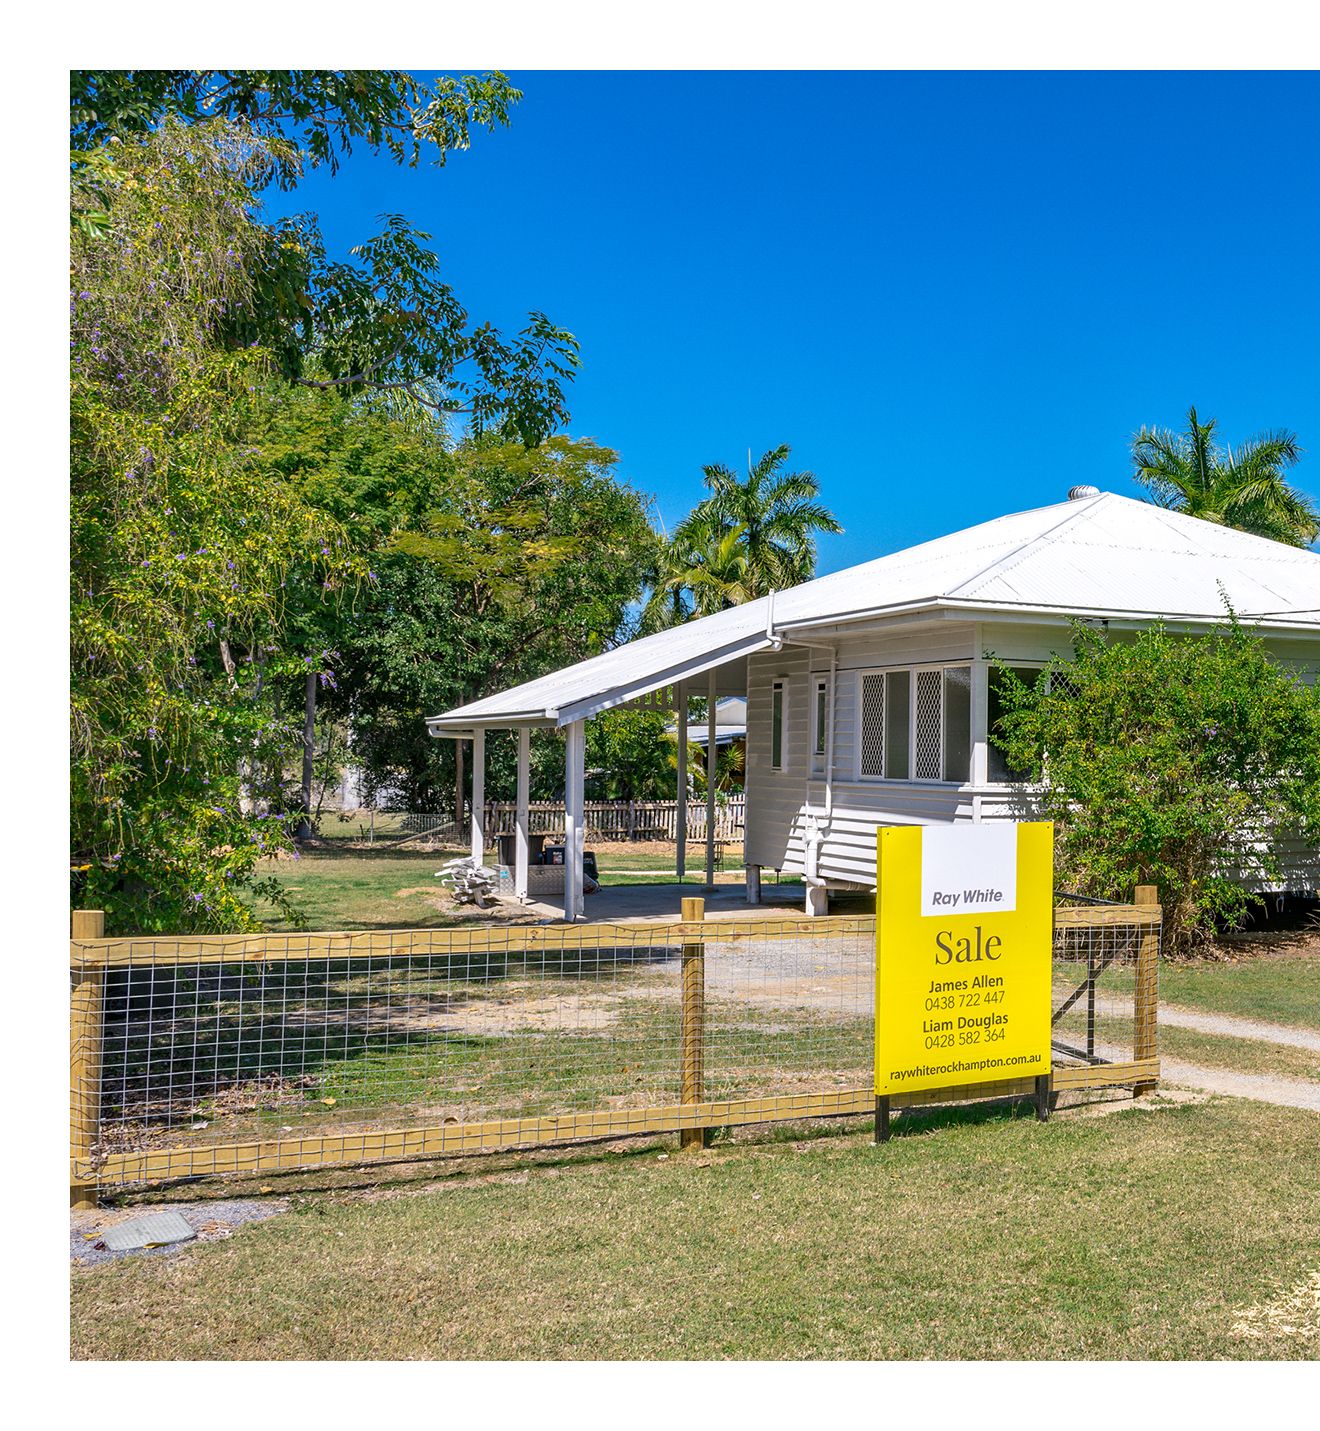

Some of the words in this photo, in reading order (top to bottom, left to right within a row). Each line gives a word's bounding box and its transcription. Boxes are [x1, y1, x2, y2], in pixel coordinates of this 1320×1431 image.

[932, 891, 960, 907] Ray
[963, 889, 1003, 904] White
[935, 926, 1002, 965] Sale
[929, 980, 968, 993] James
[972, 975, 1003, 988] Allen
[925, 996, 955, 1011] 0438
[959, 993, 981, 1007] 722
[983, 991, 1005, 1004] 447
[923, 1019, 953, 1033] Liam
[957, 1013, 1009, 1029] Douglas
[925, 1034, 955, 1050] 0428
[958, 1031, 980, 1046] 582
[983, 1028, 1006, 1043] 364
[890, 1054, 1042, 1081] raywhiterockhampton.com.au
